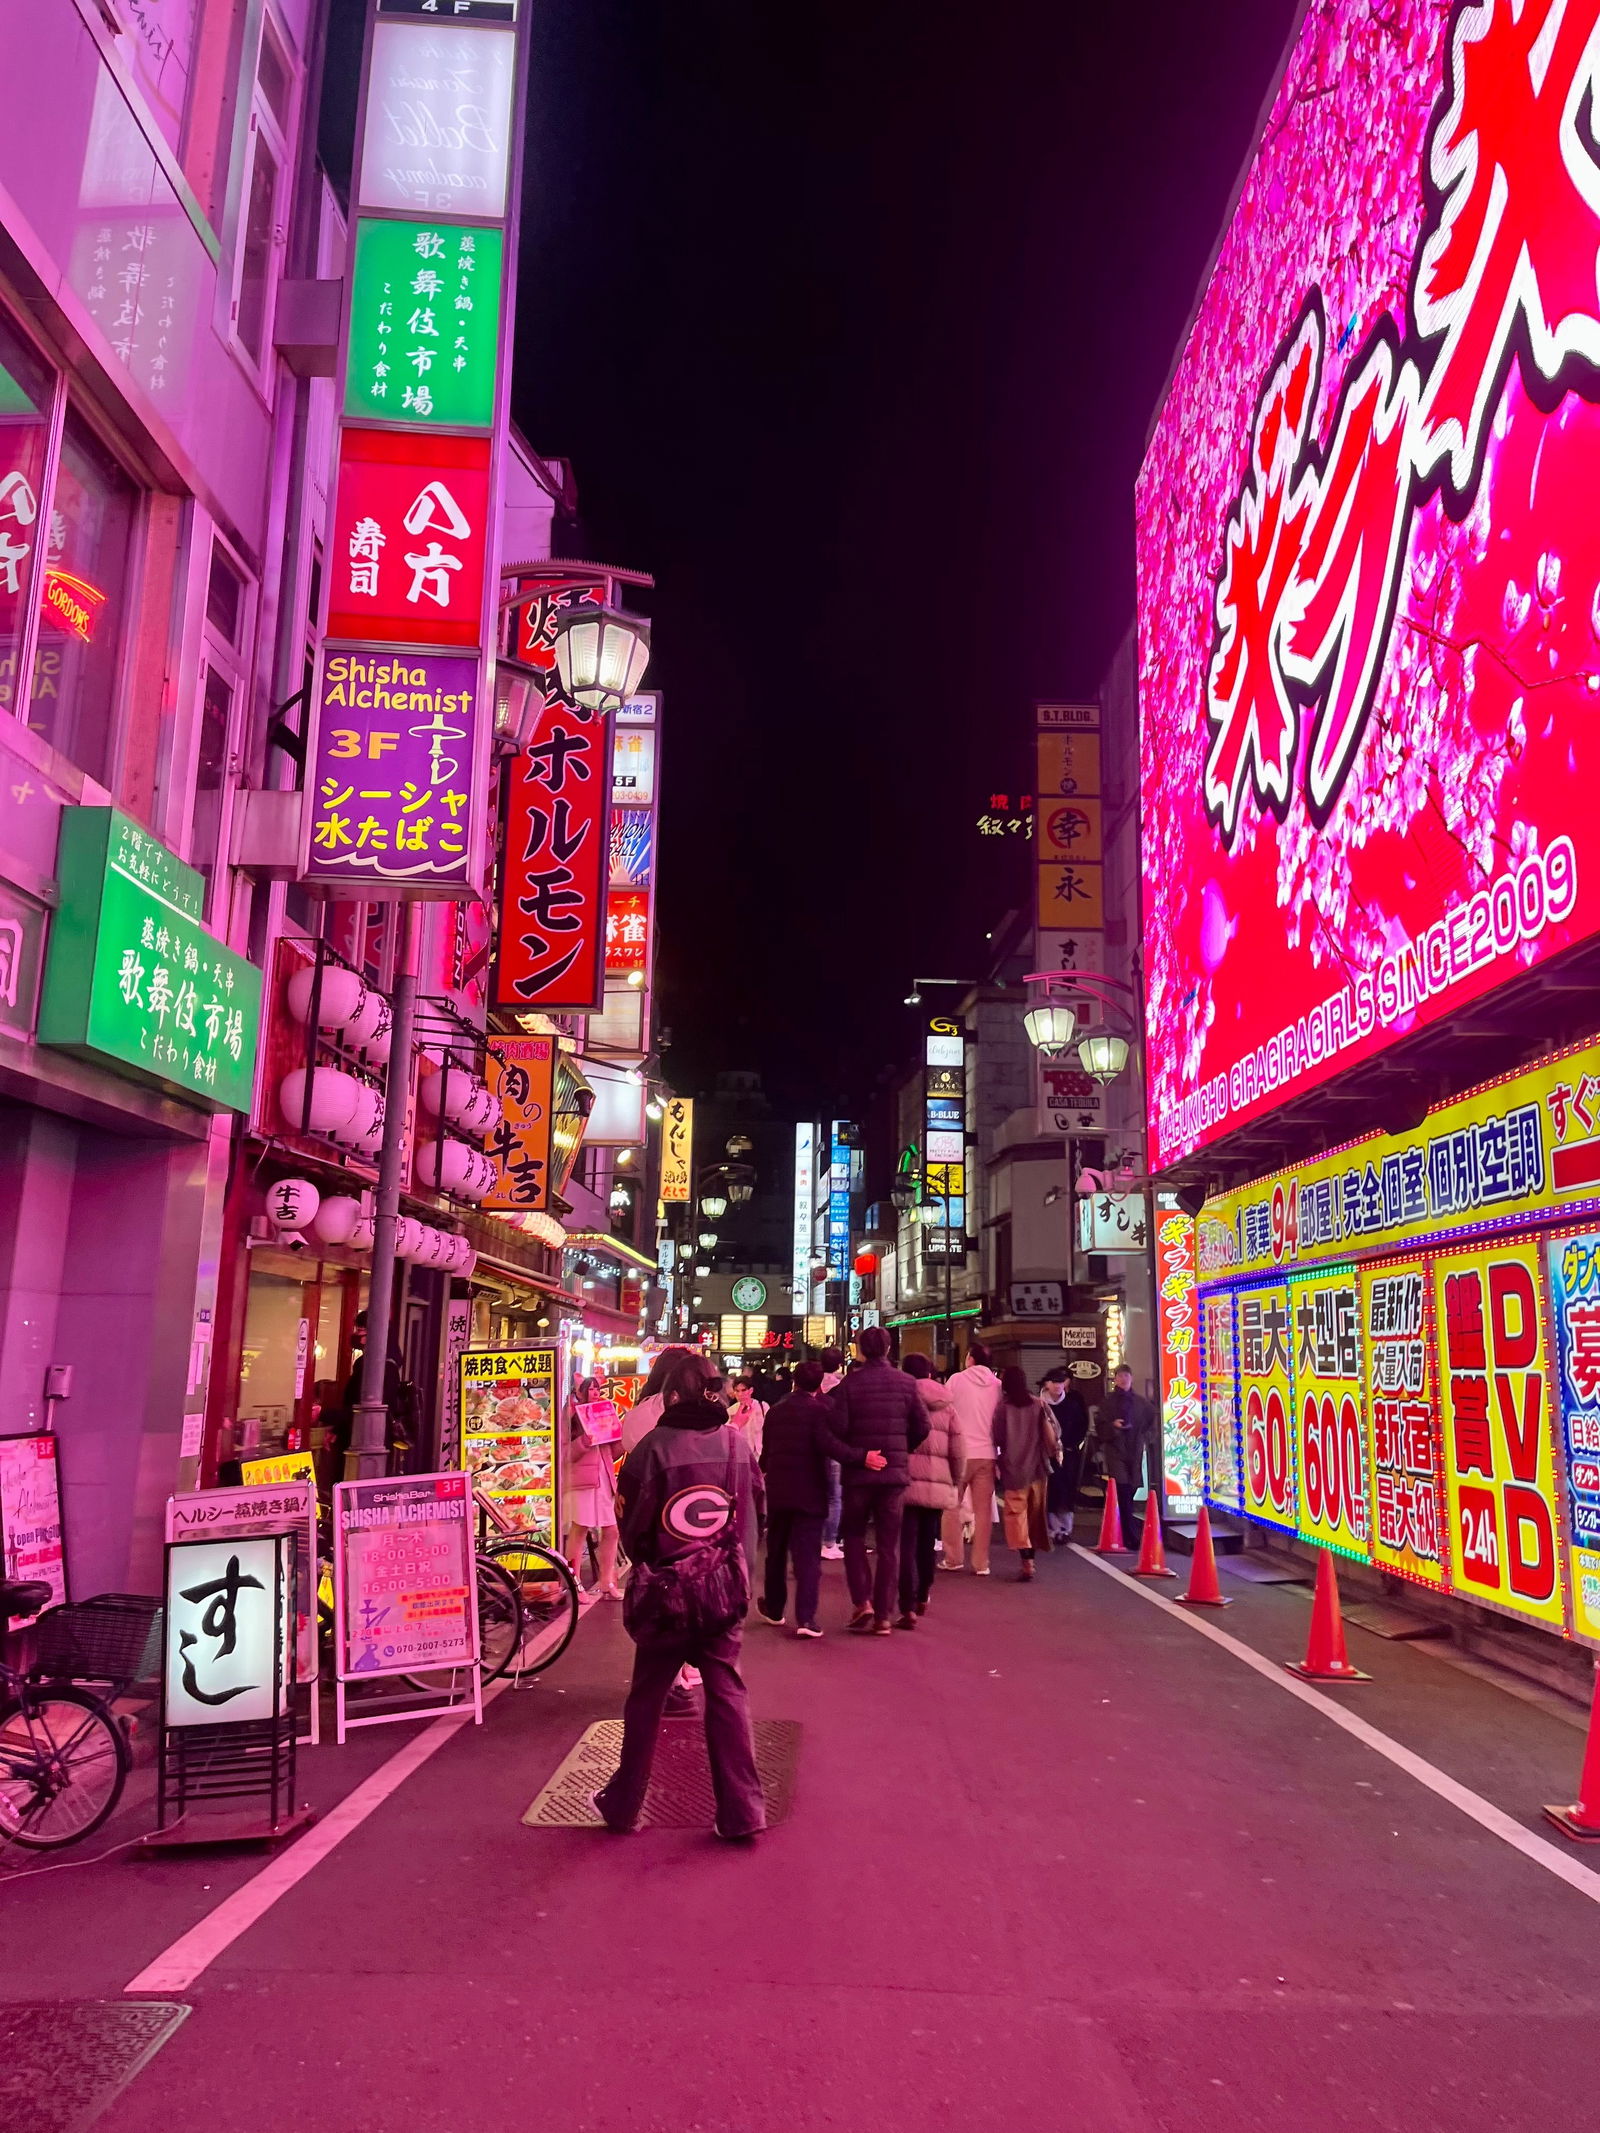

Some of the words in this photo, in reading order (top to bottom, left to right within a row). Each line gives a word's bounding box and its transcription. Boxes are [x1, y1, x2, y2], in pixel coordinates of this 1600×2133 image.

[371, 281, 392, 399] こだわり食材
[402, 231, 446, 416] 歌舞伎市場
[349, 517, 386, 596] 寿司
[403, 480, 471, 607] 八方
[326, 656, 426, 689] Shisha
[325, 681, 473, 714] Alchemist
[328, 729, 400, 759] 3F
[320, 777, 467, 817] シーシャ
[314, 813, 463, 851] 水たばこ
[1052, 867, 1093, 902] 永
[117, 949, 243, 1061] 歌舞伎市場
[140, 1027, 217, 1086] こだわり食材
[1158, 1071, 1228, 1158] KABUKICHO
[275, 1186, 300, 1221] 牛吉
[1369, 1272, 1424, 1339] 最新作
[1064, 1330, 1095, 1339] Mexican
[1242, 1296, 1288, 1377] 最大
[1298, 1287, 1359, 1379] 大型店
[464, 1353, 552, 1376] 焼肉食べ放題
[1372, 1399, 1433, 1473] 新宿
[1488, 1263, 1555, 1602] DVD
[443, 1481, 461, 1492] 3F
[341, 1507, 389, 1528] SHISHA
[395, 1500, 465, 1523] ALCHEMIST
[670, 1491, 729, 1537] G
[1376, 1474, 1440, 1564] 最大級
[363, 1545, 449, 1563] 18:00-5:00
[1462, 1507, 1499, 1569] 24h
[362, 1576, 449, 1593] 16:00-5:00
[376, 1562, 431, 1577] 金土日祝
[178, 1554, 266, 1705] すし
[397, 1638, 464, 1653] 070-2007-5273
